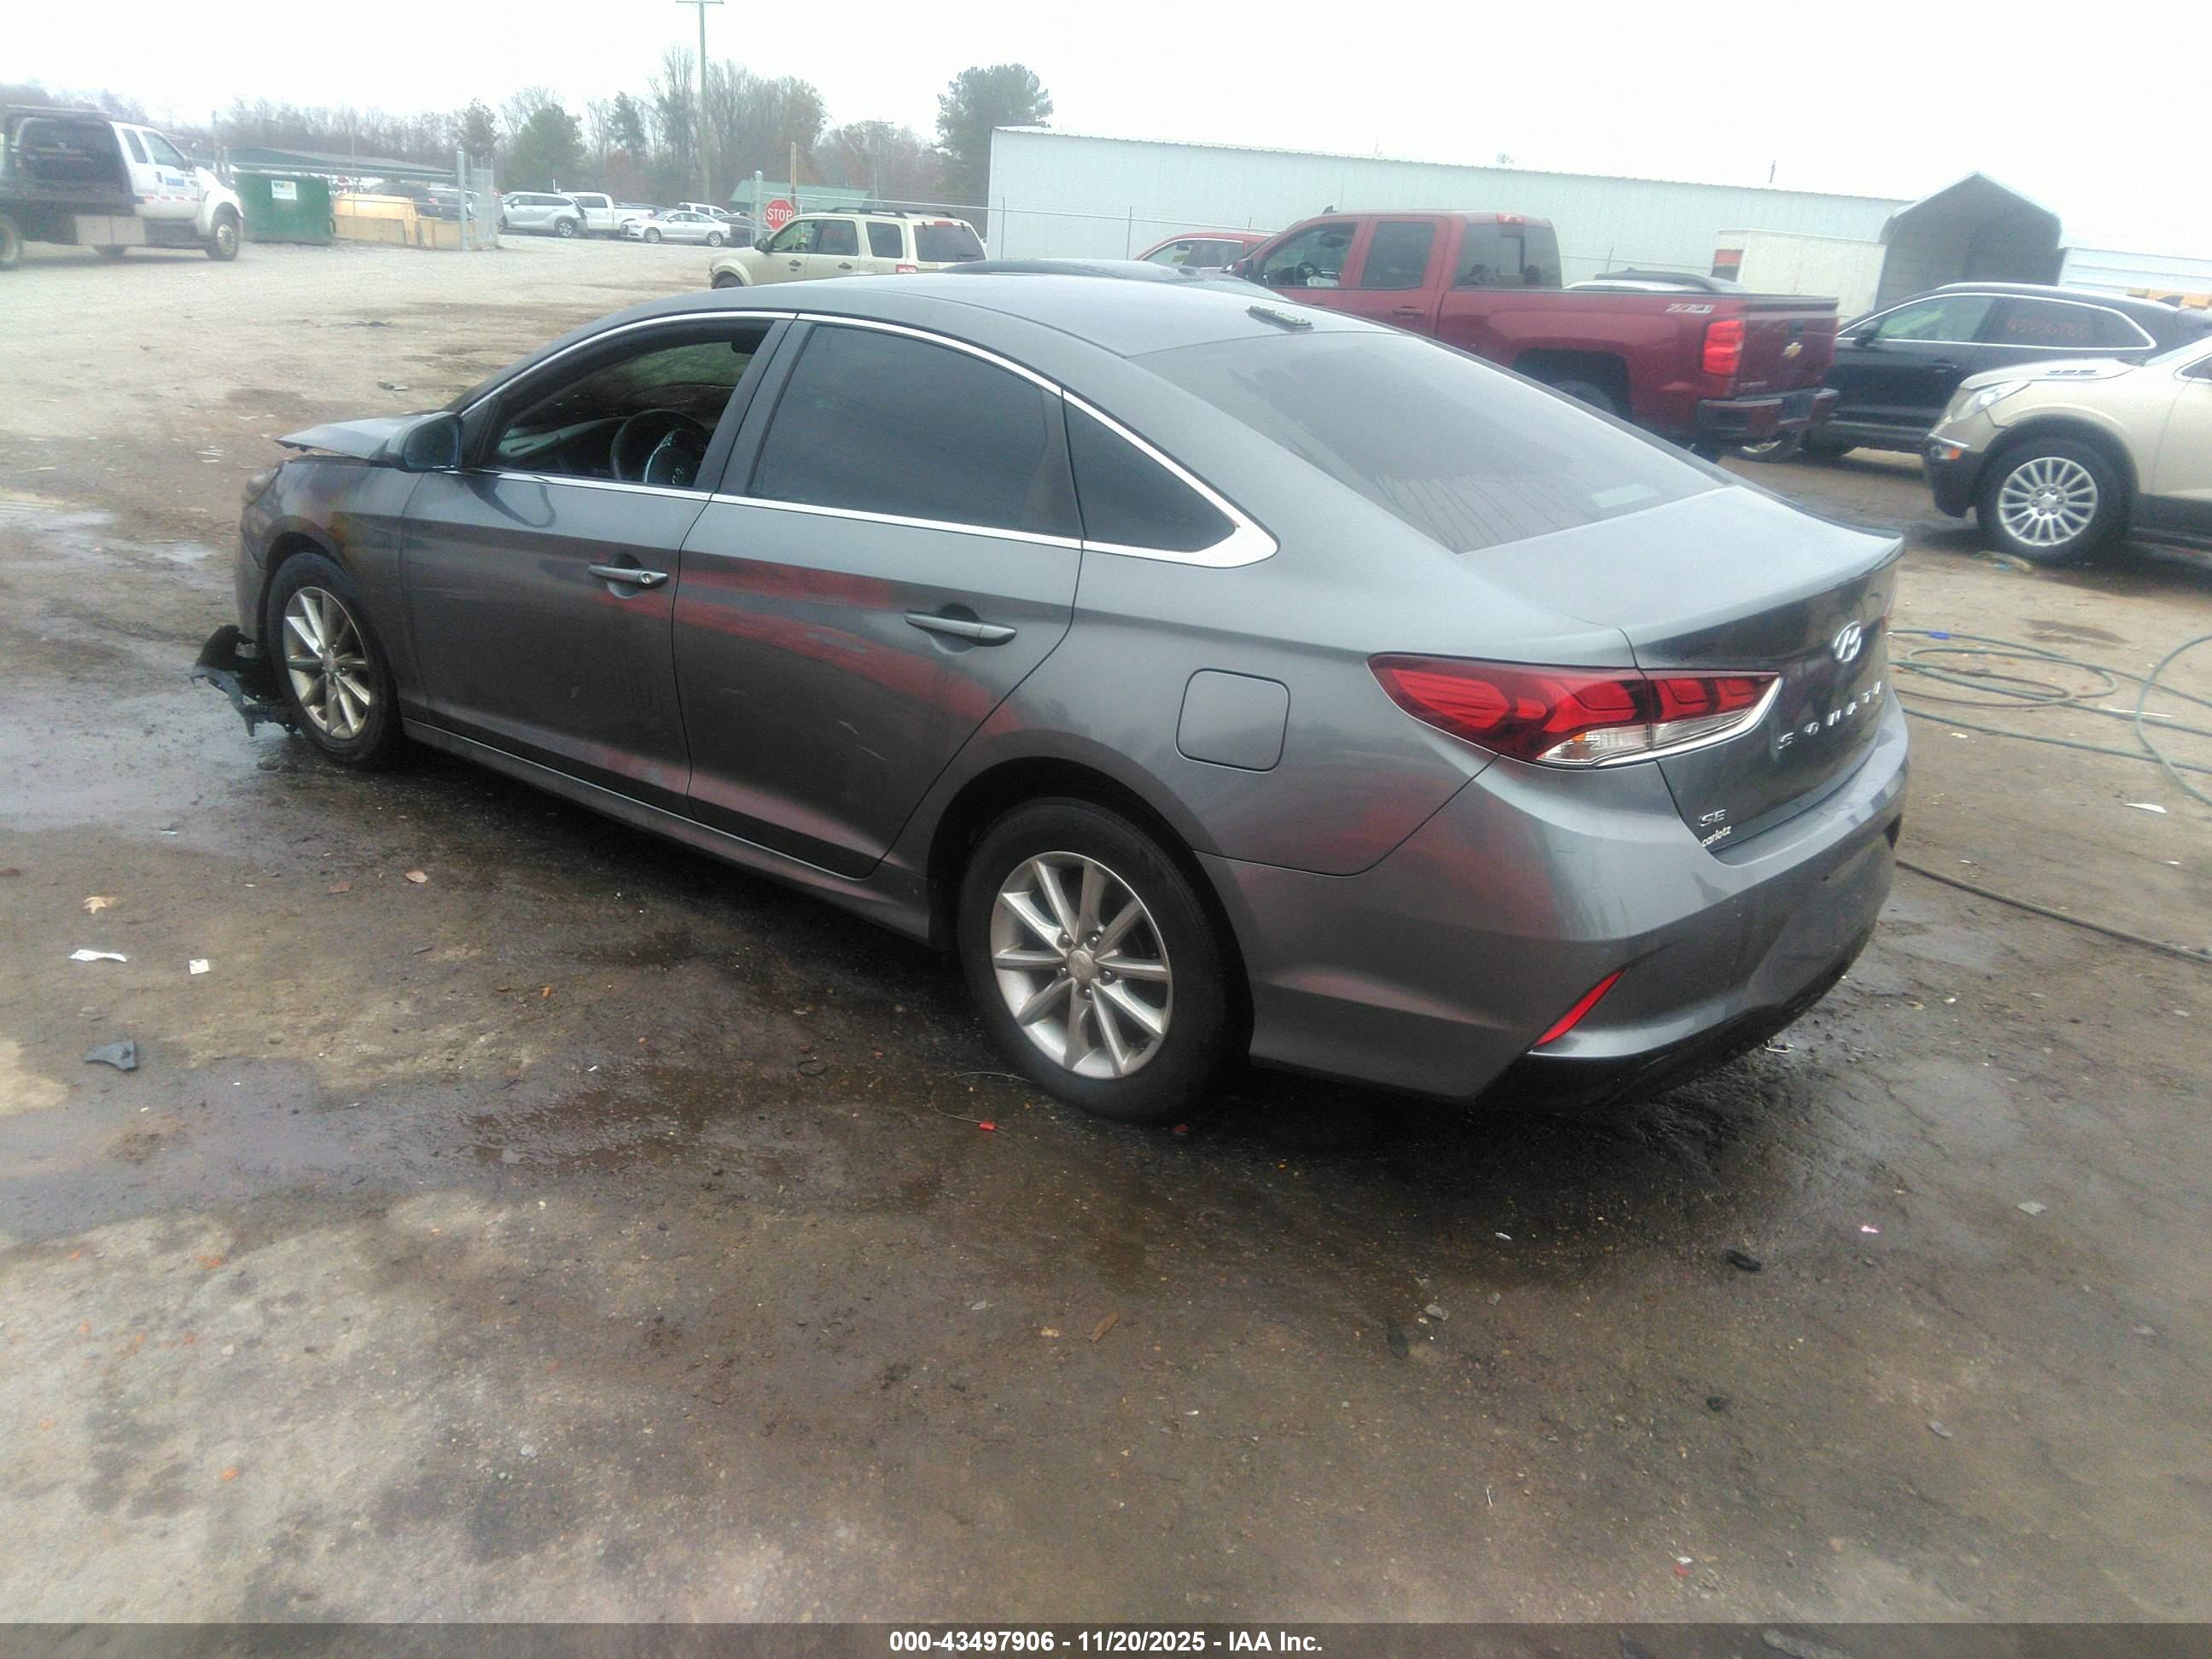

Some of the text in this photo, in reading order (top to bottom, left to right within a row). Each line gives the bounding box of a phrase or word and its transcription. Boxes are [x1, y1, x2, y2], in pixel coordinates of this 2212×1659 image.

[766, 207, 793, 222] STOP
[1699, 809, 1726, 827] SE
[1702, 825, 1732, 847] carlotz
